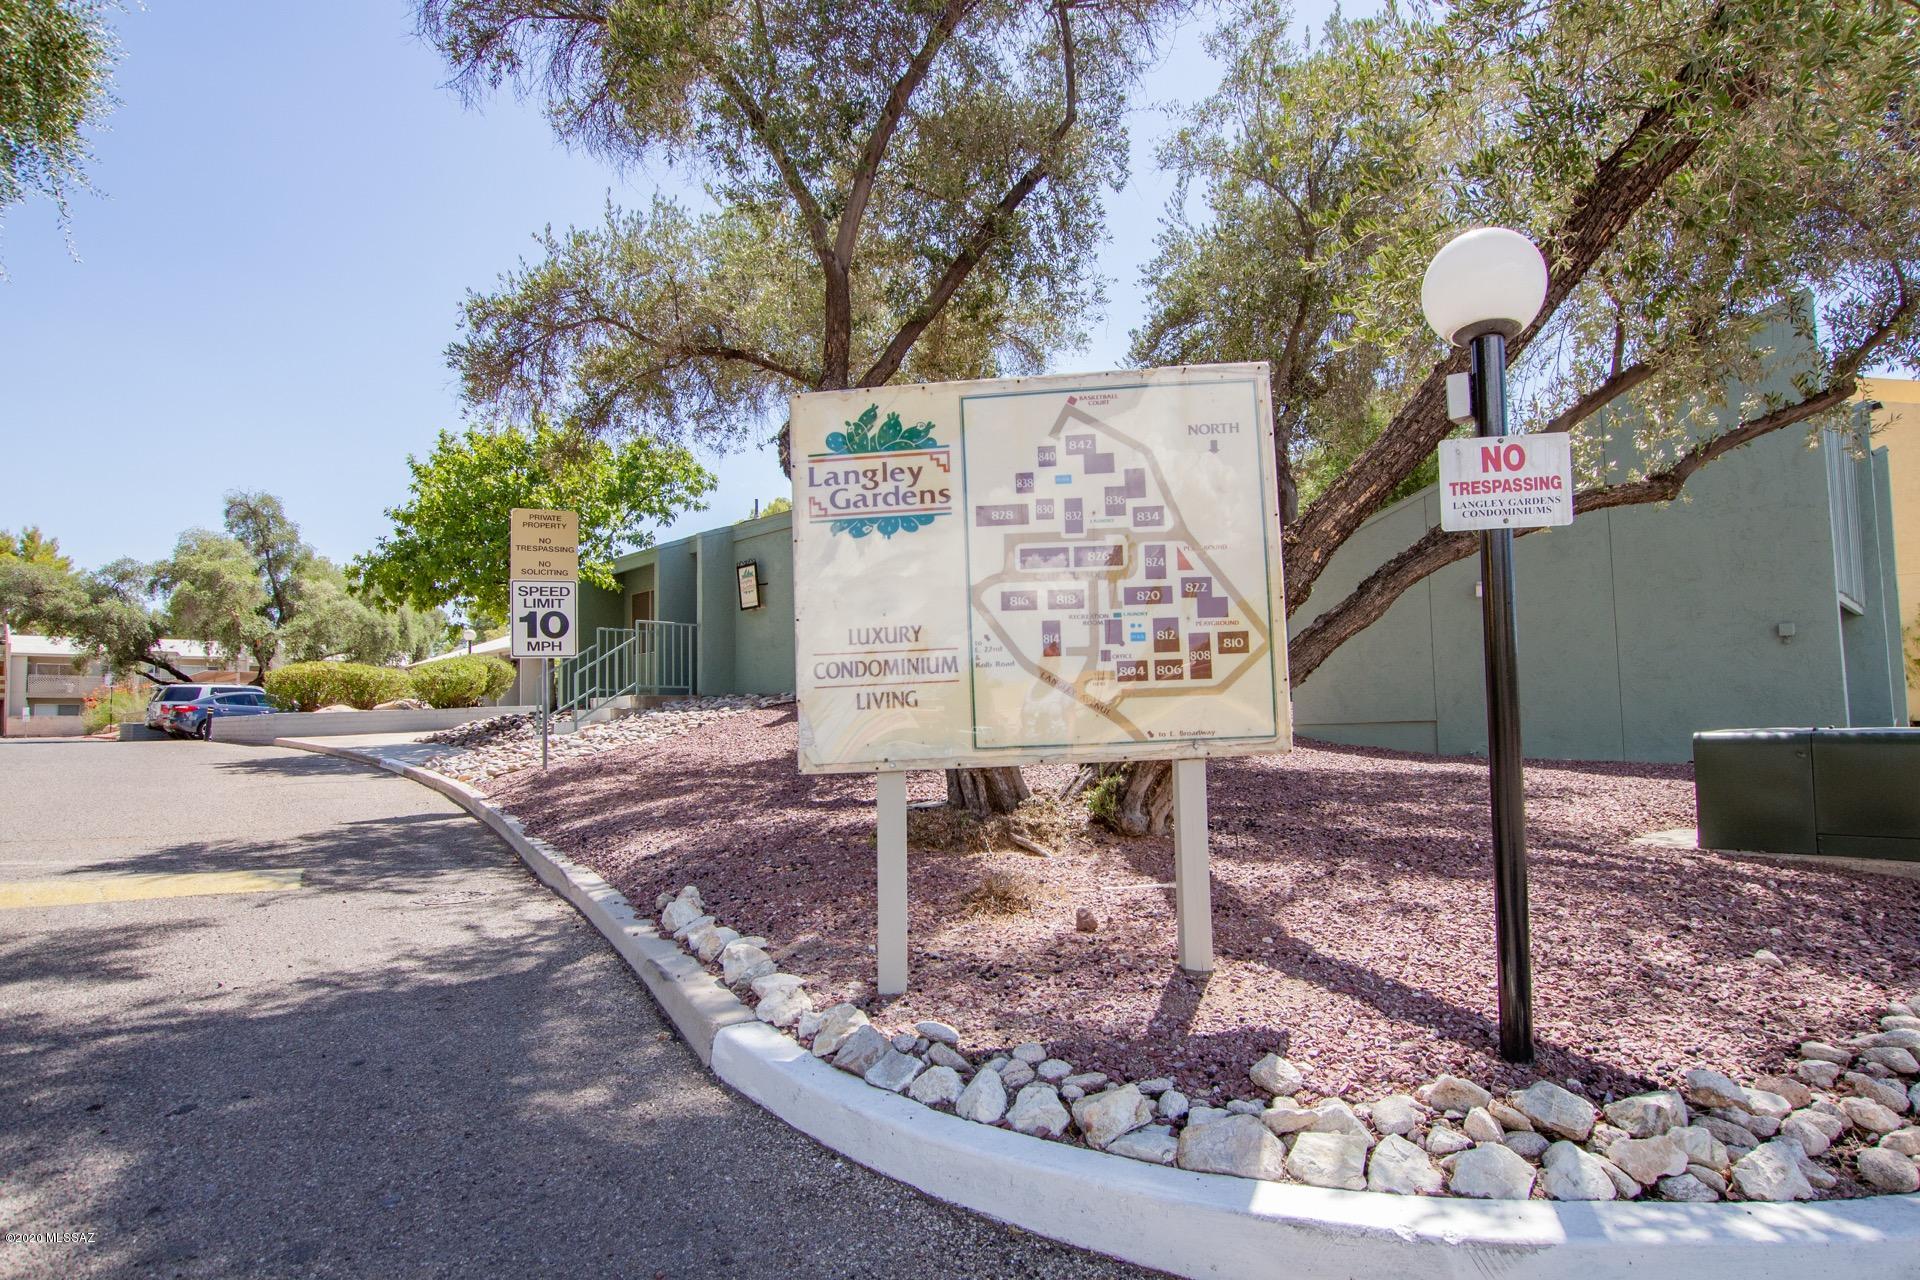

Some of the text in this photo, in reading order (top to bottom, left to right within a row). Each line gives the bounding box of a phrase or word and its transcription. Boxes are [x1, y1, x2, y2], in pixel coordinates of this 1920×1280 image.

[1187, 422, 1240, 435] NORTH
[1069, 440, 1093, 449] 842
[1039, 451, 1056, 461] 840
[1480, 443, 1526, 473] NO
[808, 461, 924, 491] Langley
[1016, 478, 1034, 488] 838
[1448, 475, 1562, 497] TRESPASSING
[829, 485, 952, 510] Gardens
[1105, 495, 1126, 505] 836
[1453, 495, 1561, 510] LANGLEY GARDENS
[1036, 504, 1054, 514] 830
[1462, 505, 1553, 519] CONDOMINIUMS
[529, 513, 562, 522] PRIVATE
[991, 510, 1014, 520] 828
[1064, 511, 1082, 520] 832
[1136, 511, 1160, 521] 834
[522, 521, 567, 530] PROPERTY
[538, 537, 552, 545] NO
[516, 544, 575, 553] TRESPASSING
[1087, 551, 1109, 561] 826
[538, 560, 552, 568] NO
[1145, 557, 1165, 567] 824
[521, 568, 569, 577] SOLICITING
[518, 585, 570, 597] SPEED
[1185, 582, 1208, 593] 822
[1009, 595, 1029, 606] 816
[1055, 594, 1076, 605] 818
[1136, 590, 1160, 601] 820
[523, 598, 565, 609] LIMIT
[519, 610, 570, 639] 10
[848, 625, 922, 646] LUXURY
[1043, 634, 1059, 643] 814
[1156, 630, 1176, 640] 812
[527, 641, 562, 652] MPH
[1223, 637, 1244, 648] 810
[1190, 650, 1211, 661] 808
[813, 655, 960, 680] CONDOMINIUM
[1119, 666, 1146, 676] 804
[1156, 665, 1182, 675] 806
[856, 690, 919, 711] LIVING
